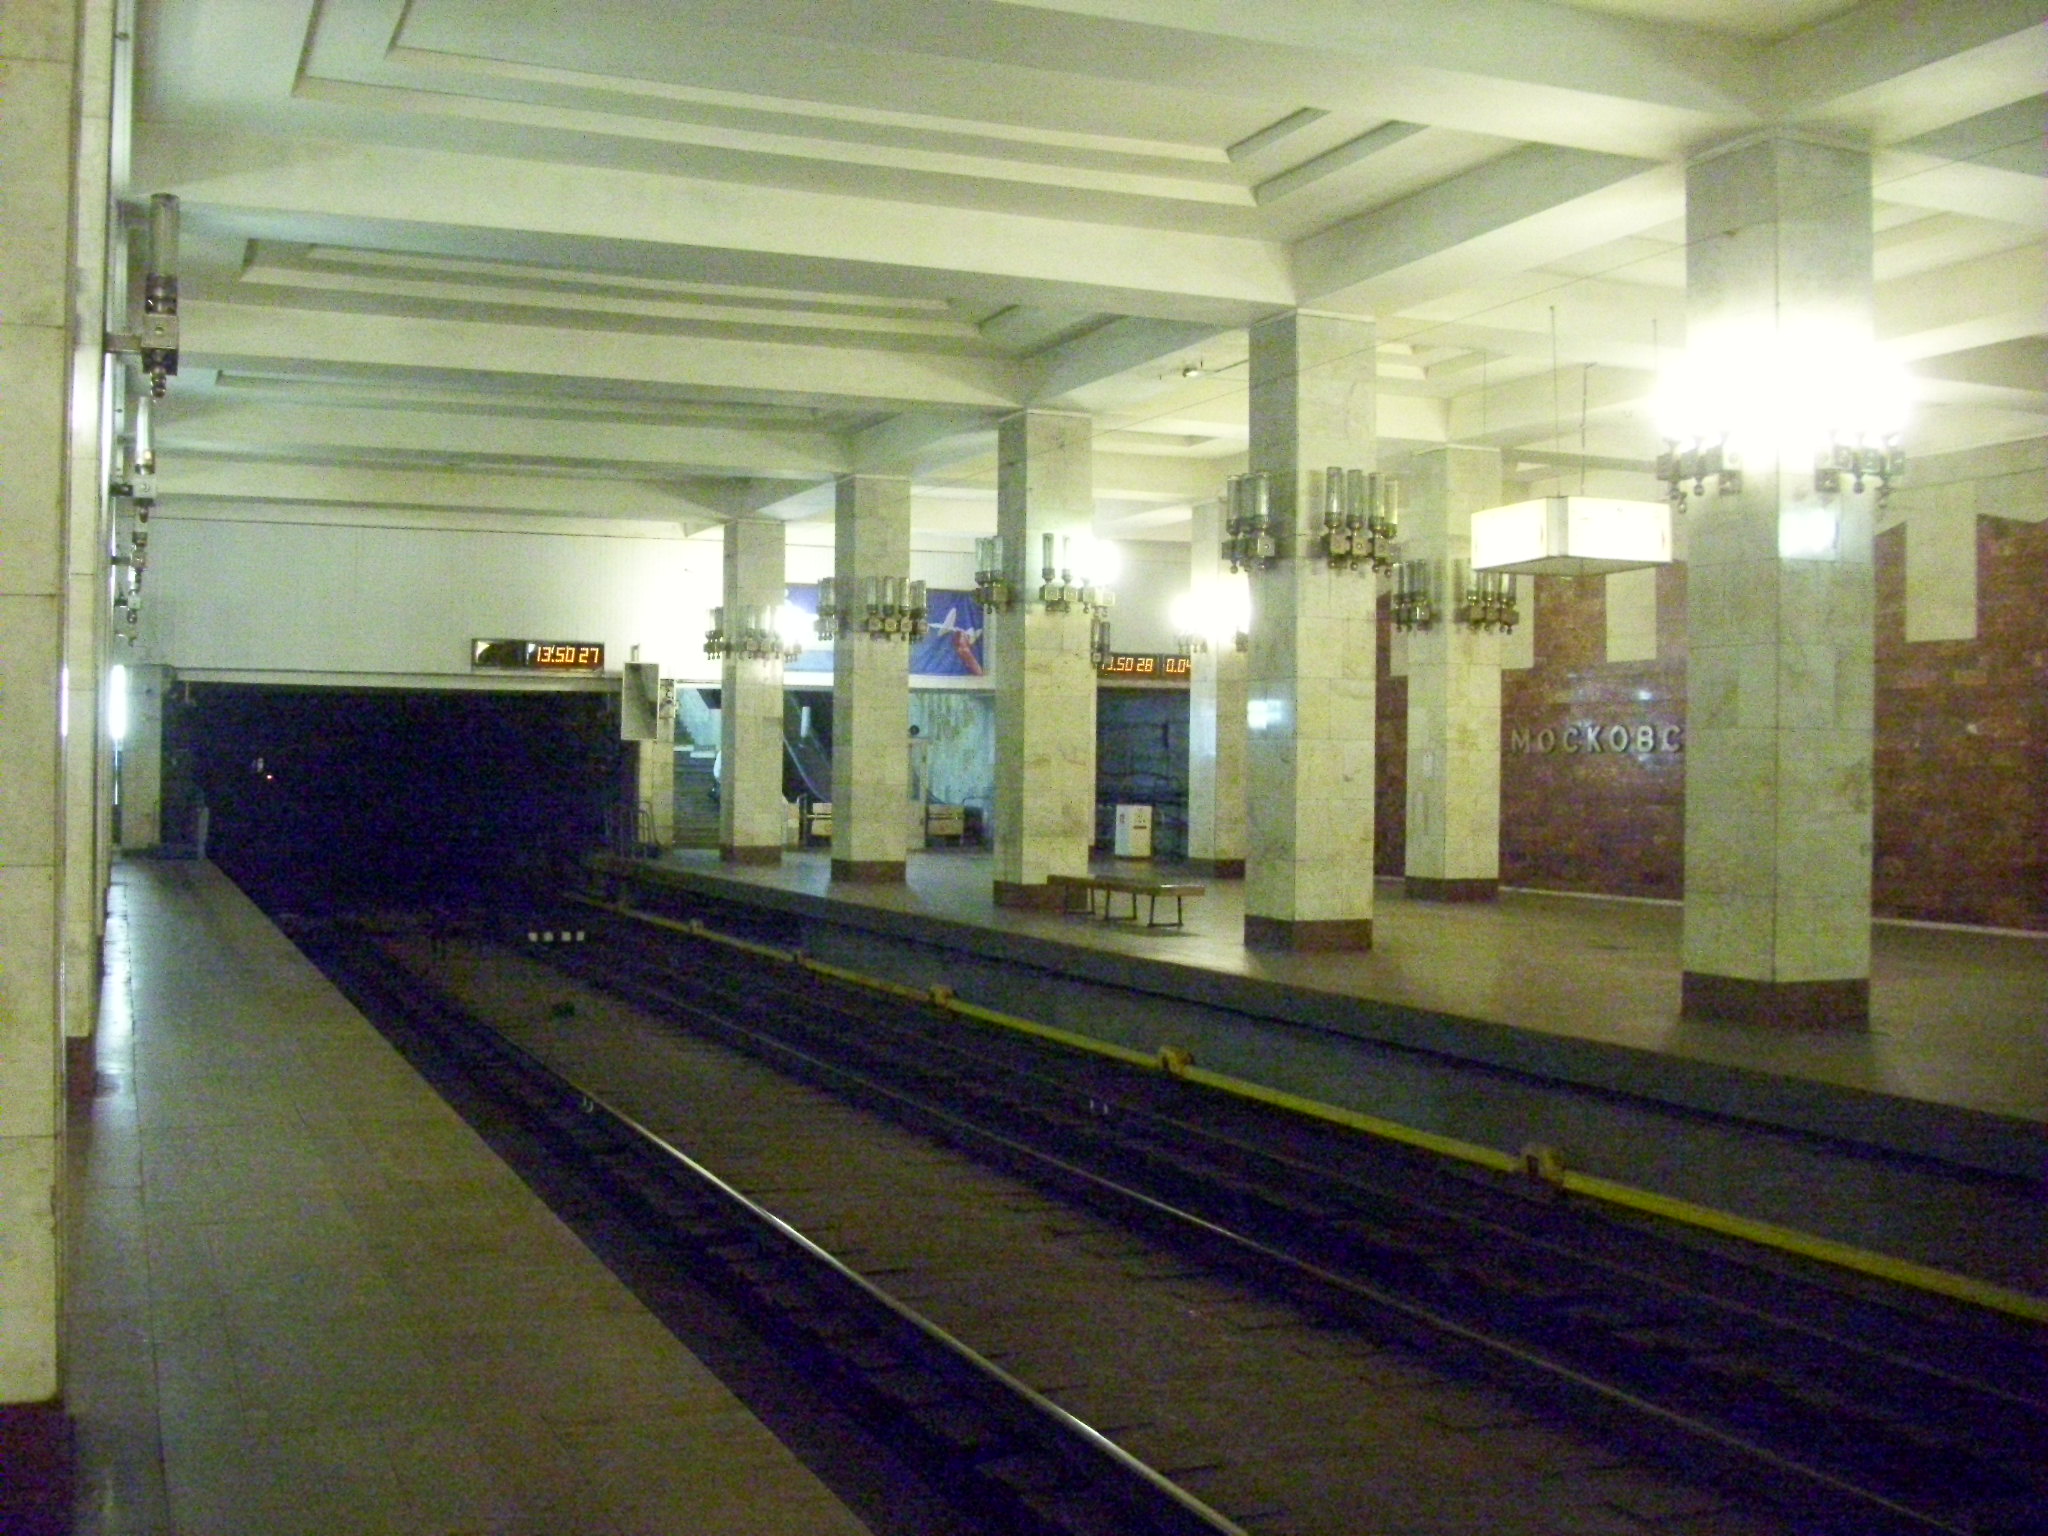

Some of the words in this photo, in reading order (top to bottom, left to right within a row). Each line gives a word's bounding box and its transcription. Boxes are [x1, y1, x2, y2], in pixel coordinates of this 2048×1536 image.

[579, 647, 599, 663] 27
[1136, 657, 1154, 672] 28
[1511, 725, 1681, 753] МОСКОВС
